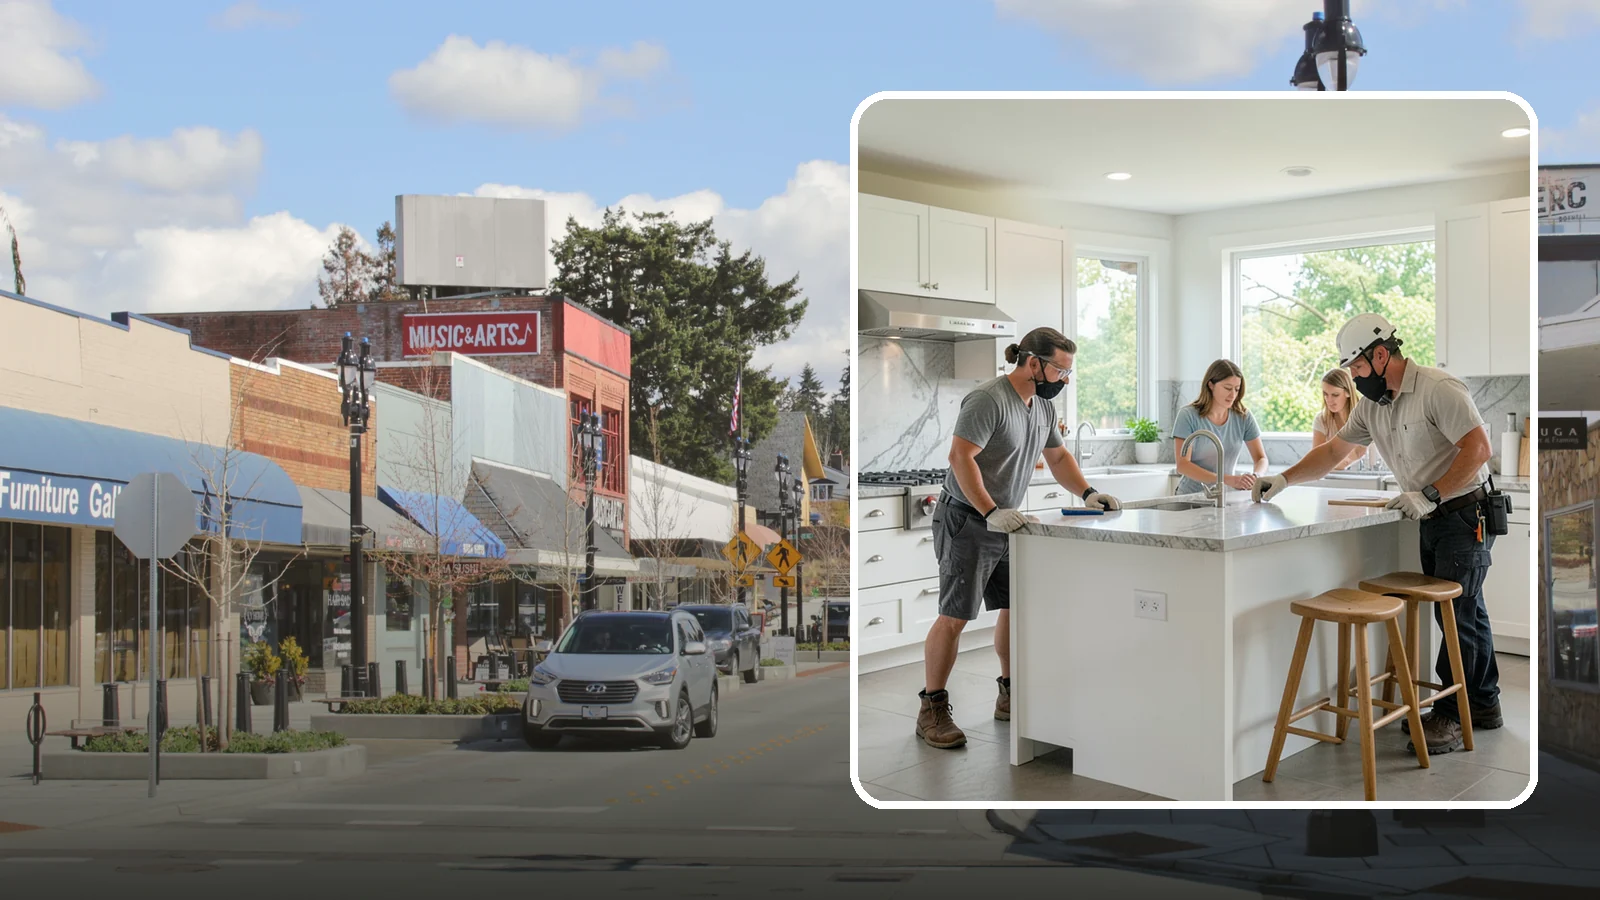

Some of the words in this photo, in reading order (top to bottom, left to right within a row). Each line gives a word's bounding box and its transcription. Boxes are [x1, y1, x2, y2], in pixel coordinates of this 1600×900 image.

[408, 322, 520, 349] MUSIC&ARTS
[1540, 428, 1577, 436] UGA
[0, 471, 79, 515] Furniture
[89, 482, 121, 519] Gal
[453, 562, 479, 574] SUSHI
